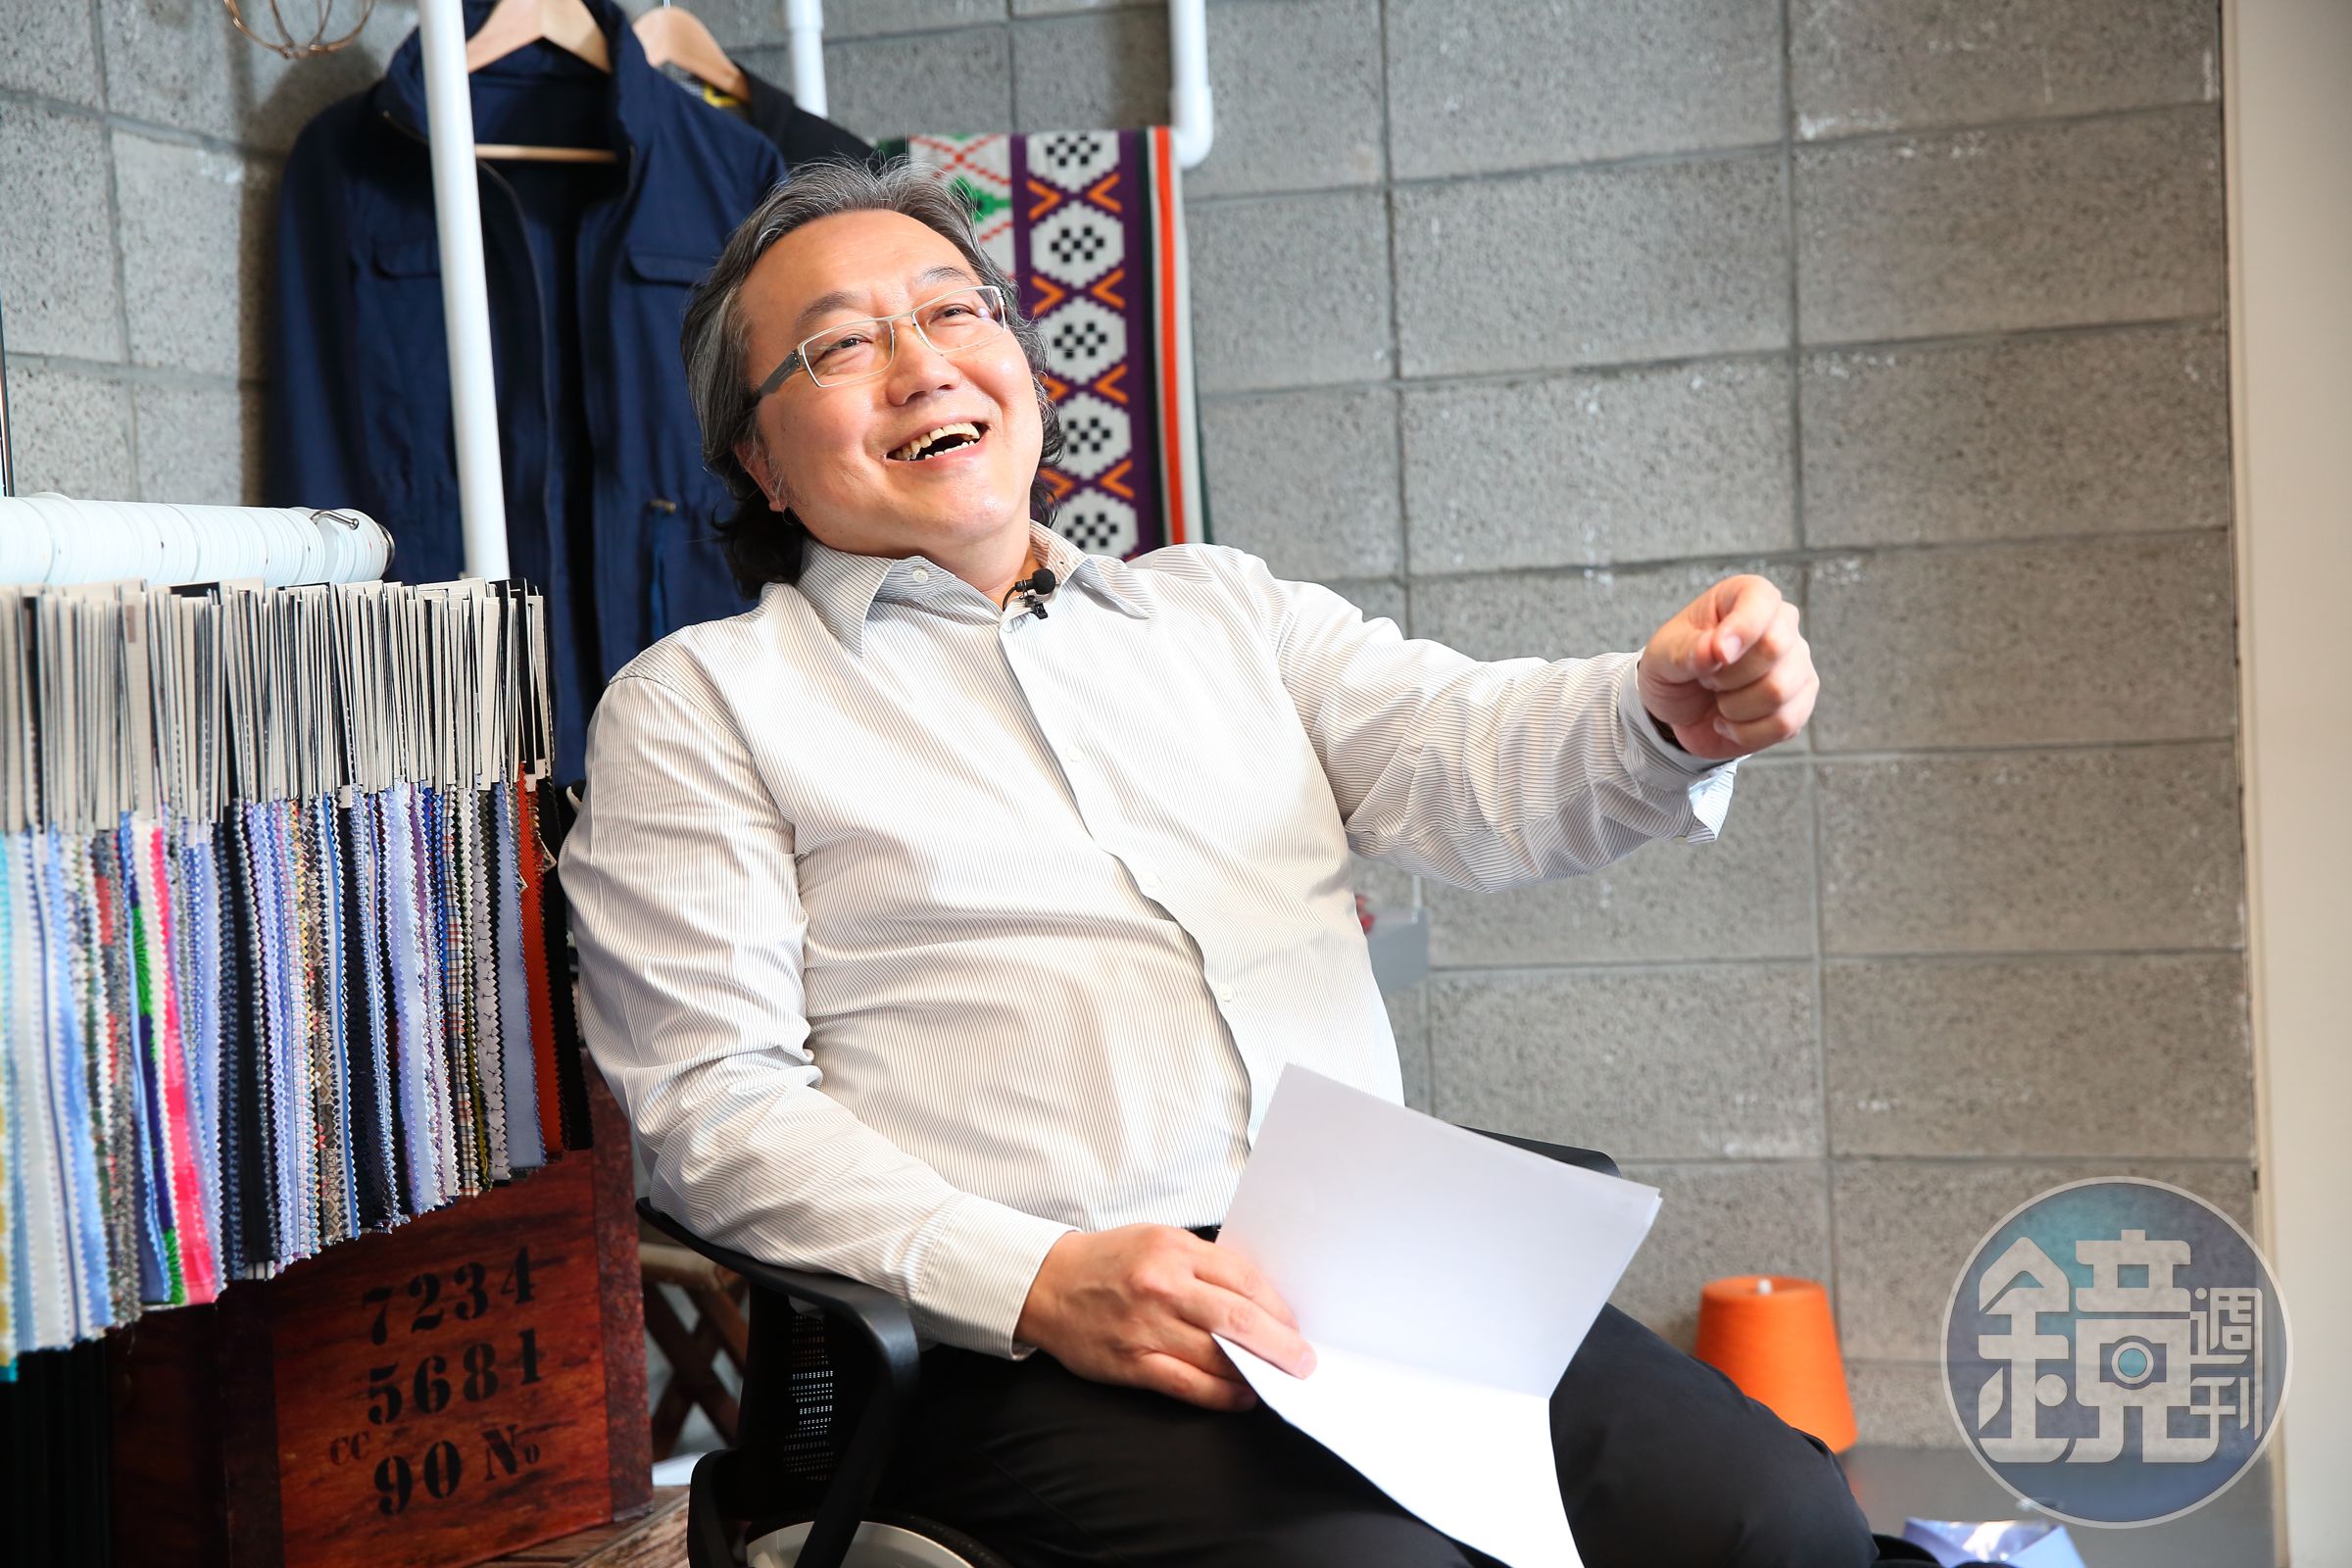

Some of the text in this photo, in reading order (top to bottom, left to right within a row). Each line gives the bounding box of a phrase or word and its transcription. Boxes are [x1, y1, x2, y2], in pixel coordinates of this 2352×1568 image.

[363, 1248, 536, 1346] 7234
[368, 1328, 542, 1425] 5681
[373, 1441, 462, 1516] 90
